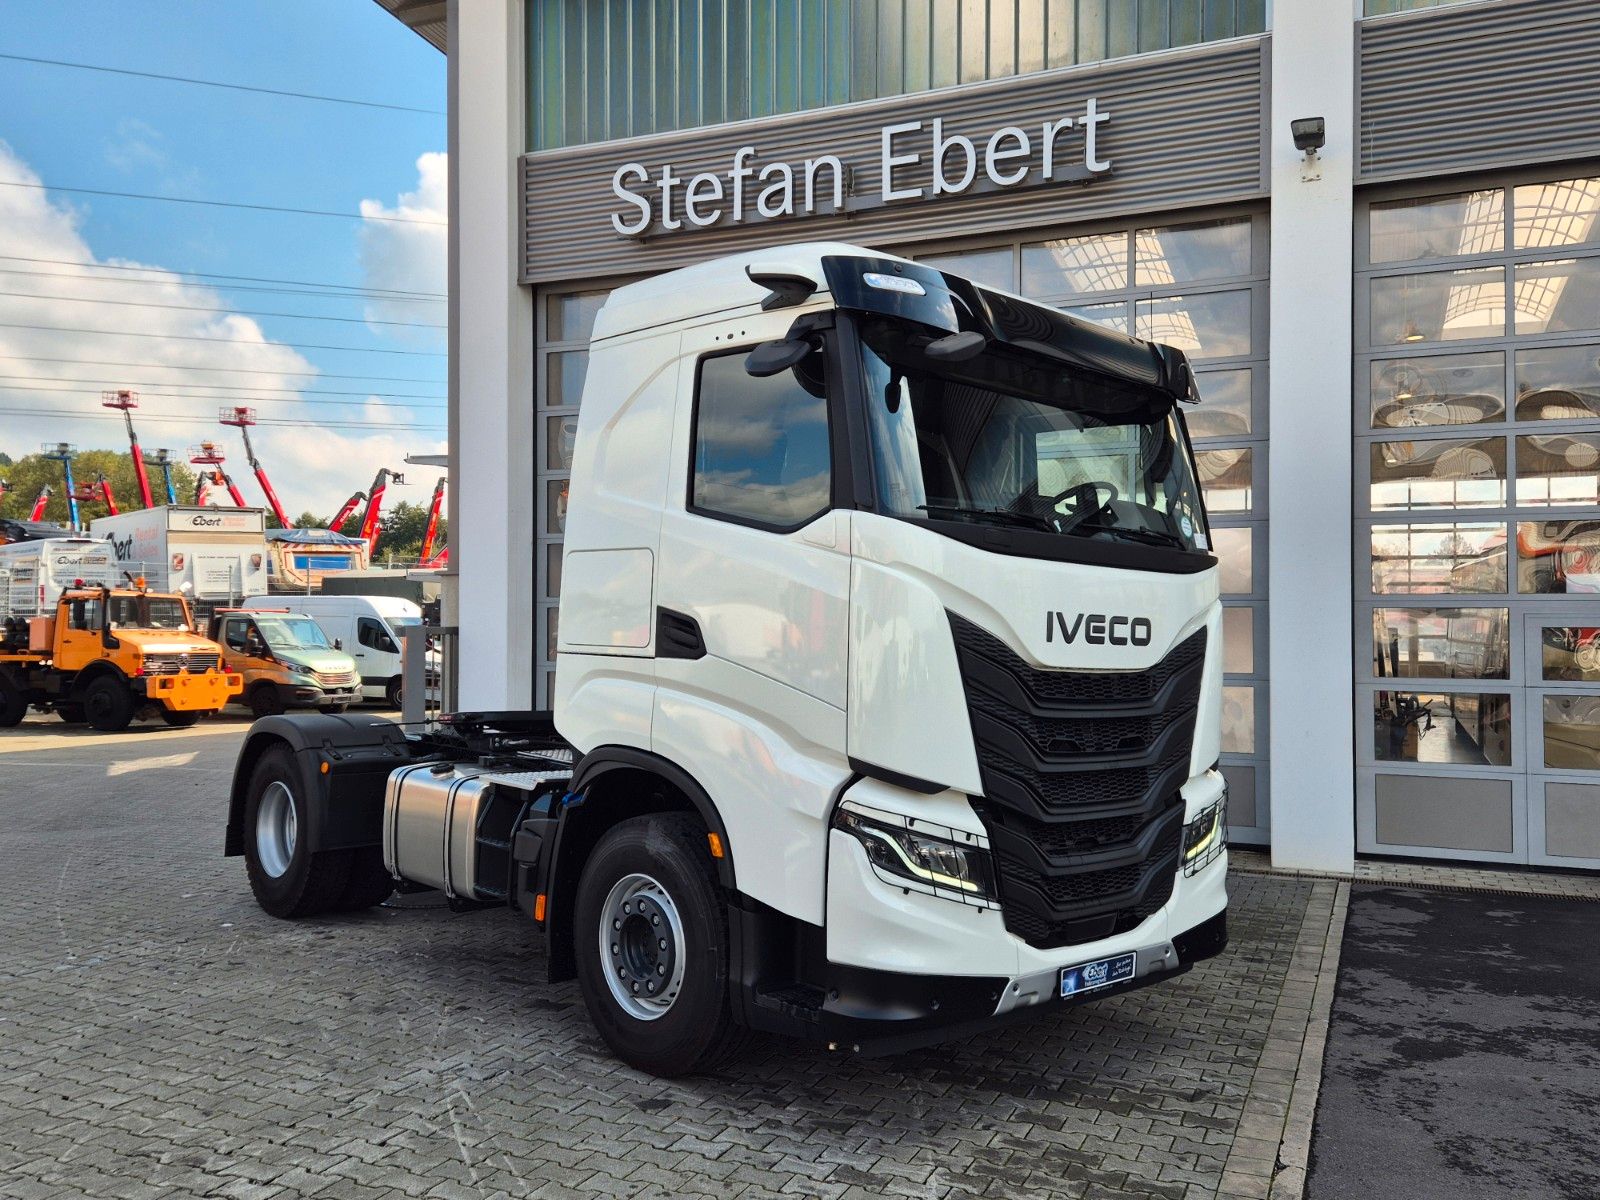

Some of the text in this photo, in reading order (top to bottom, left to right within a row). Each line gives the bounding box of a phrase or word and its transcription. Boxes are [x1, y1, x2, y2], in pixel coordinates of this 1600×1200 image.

[610, 98, 1111, 236] Stefan Ebert
[192, 515, 222, 527] Ebert
[57, 556, 82, 565] Ebert
[106, 532, 132, 561] bert
[1046, 611, 1152, 646] IVECO
